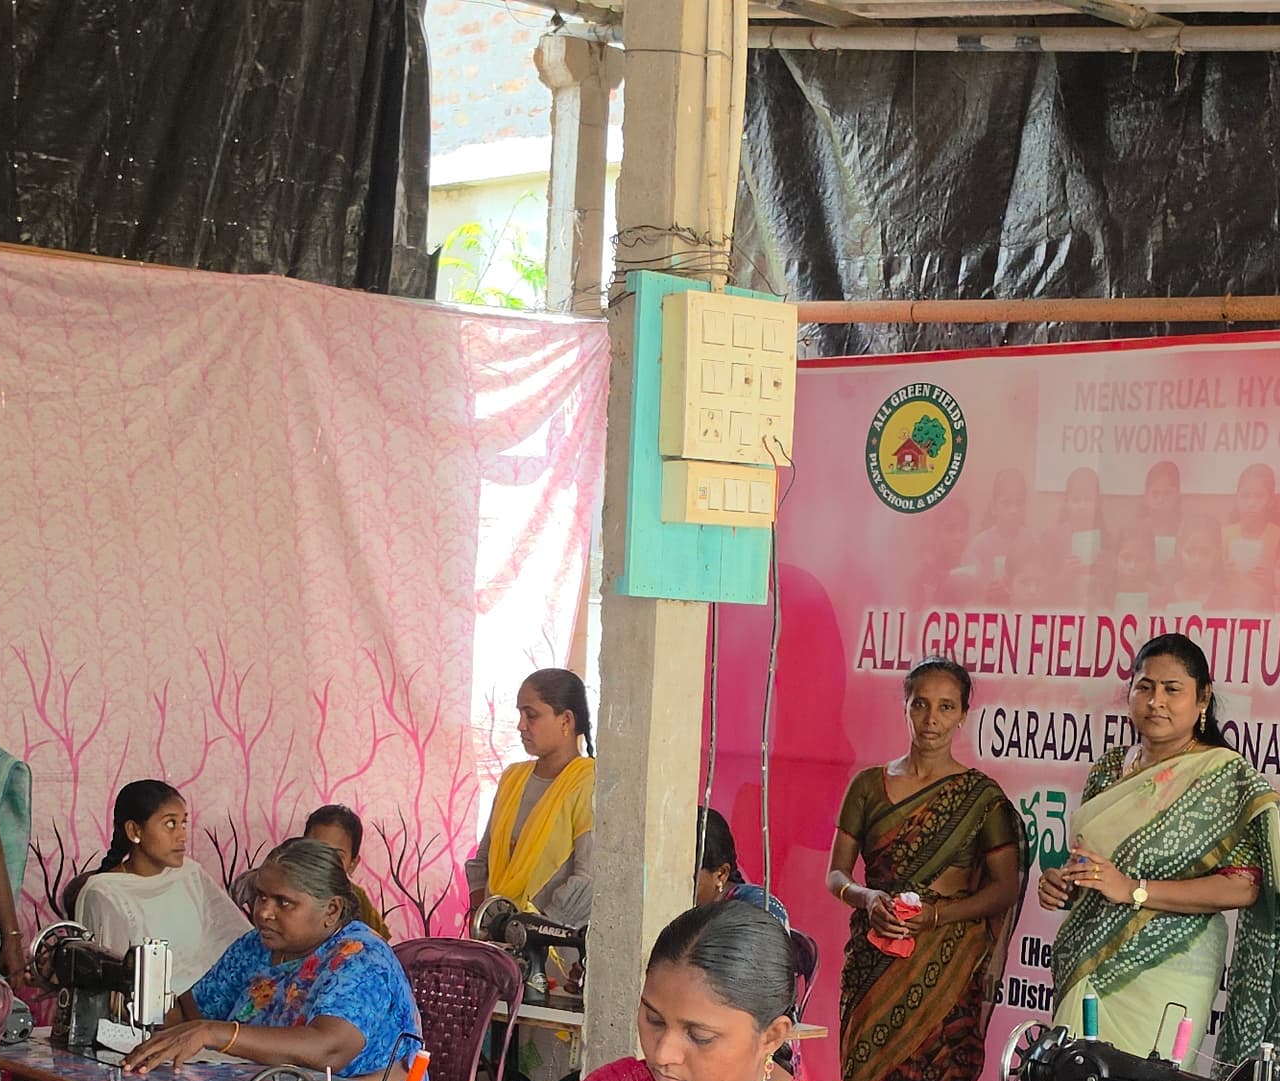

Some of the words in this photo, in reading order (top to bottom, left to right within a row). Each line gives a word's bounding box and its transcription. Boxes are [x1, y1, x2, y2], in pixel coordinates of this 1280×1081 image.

[873, 404, 892, 431] ALL
[890, 384, 931, 405] GREEN
[932, 387, 964, 430] FIELDS
[1073, 377, 1226, 412] MENSTRUAL
[1061, 424, 1105, 453] FOR
[1113, 422, 1207, 453] WOMEN
[1216, 421, 1269, 451] AND
[869, 453, 883, 484] PLAY
[878, 484, 915, 510] SCHOOL
[917, 499, 926, 509] &
[926, 484, 946, 504] DAY
[944, 453, 962, 485] CARE
[857, 611, 913, 670] ALL
[921, 611, 1023, 675] GREEN
[1027, 613, 1138, 679] FIELDS
